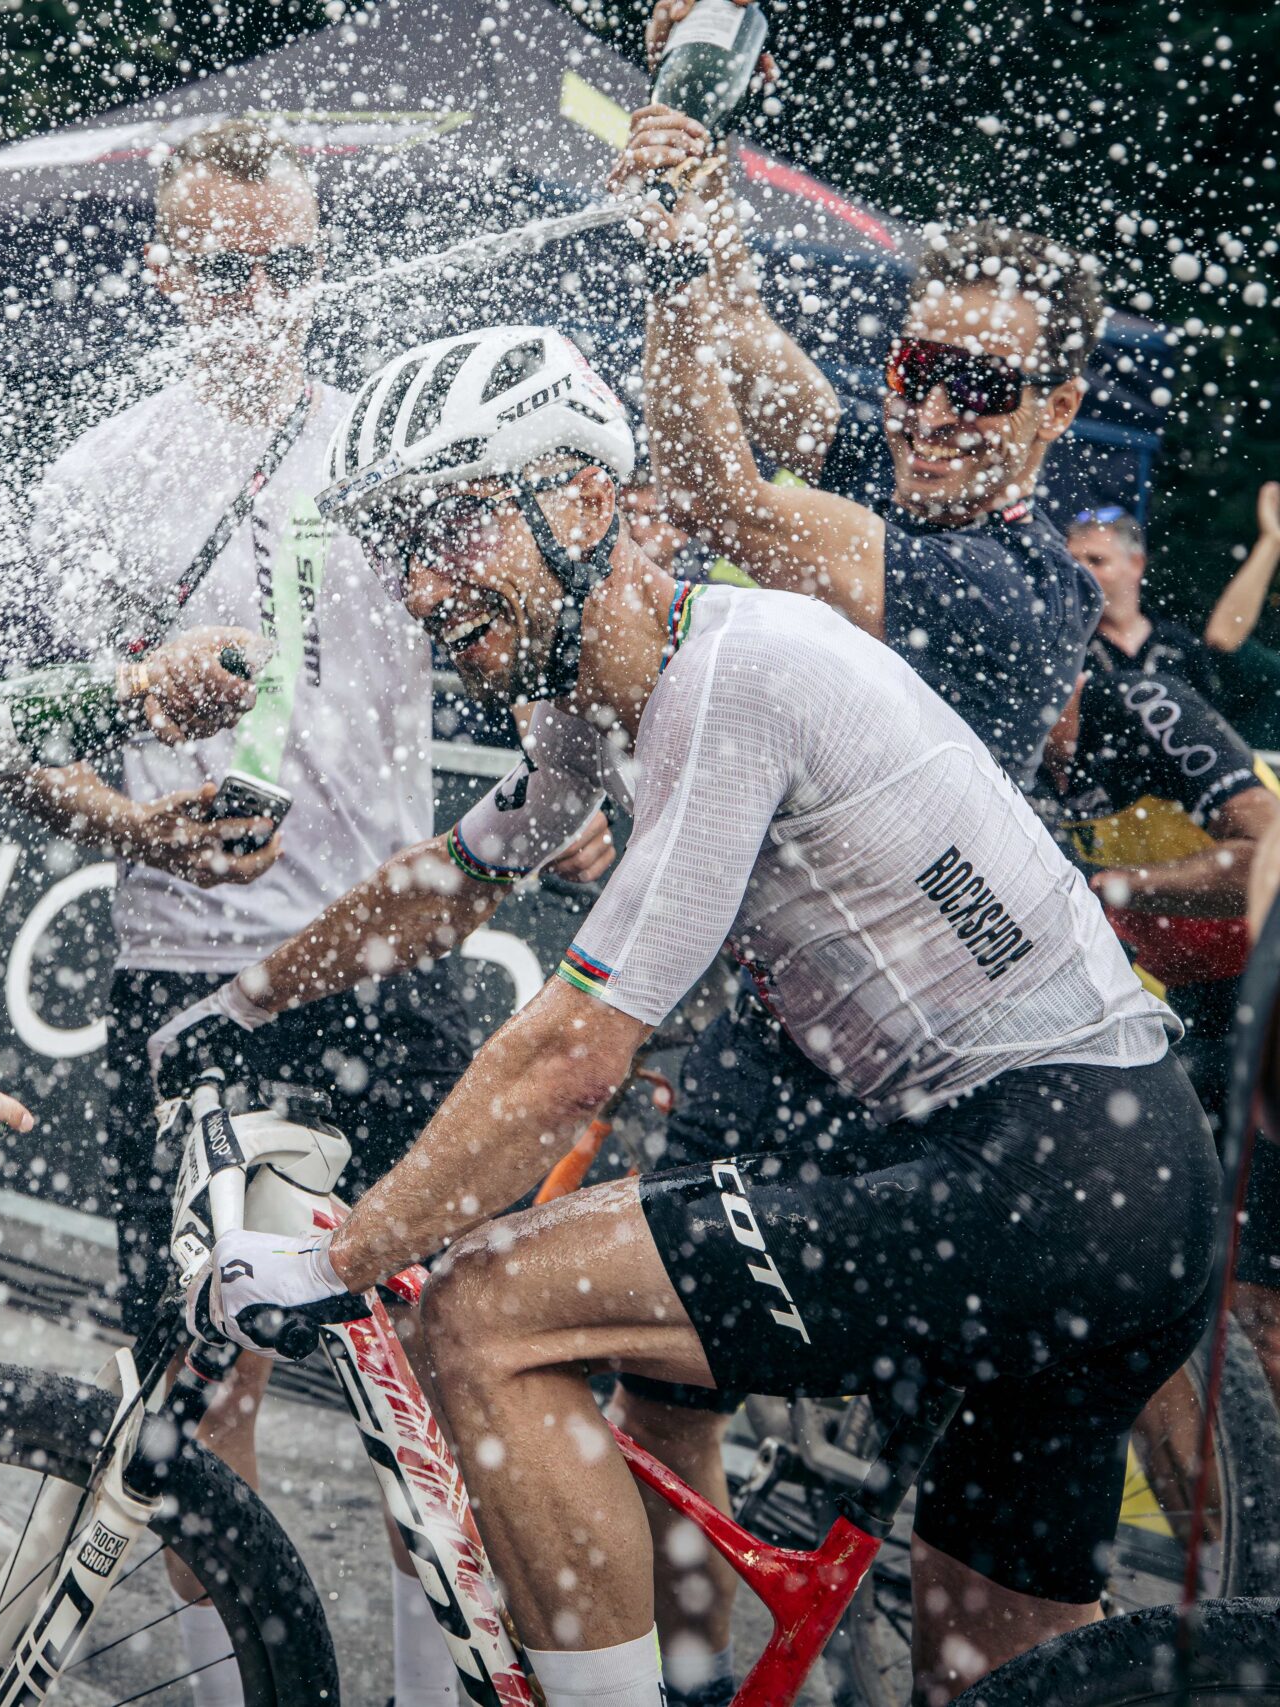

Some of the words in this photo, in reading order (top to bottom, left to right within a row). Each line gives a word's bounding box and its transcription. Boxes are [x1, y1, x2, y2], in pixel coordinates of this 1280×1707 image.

[496, 373, 572, 430] SCOTT
[915, 844, 1034, 982] ROCKSHOX
[711, 1157, 812, 1345] COTT
[80, 1545, 114, 1574] SHOX
[92, 1527, 126, 1557] ROCK
